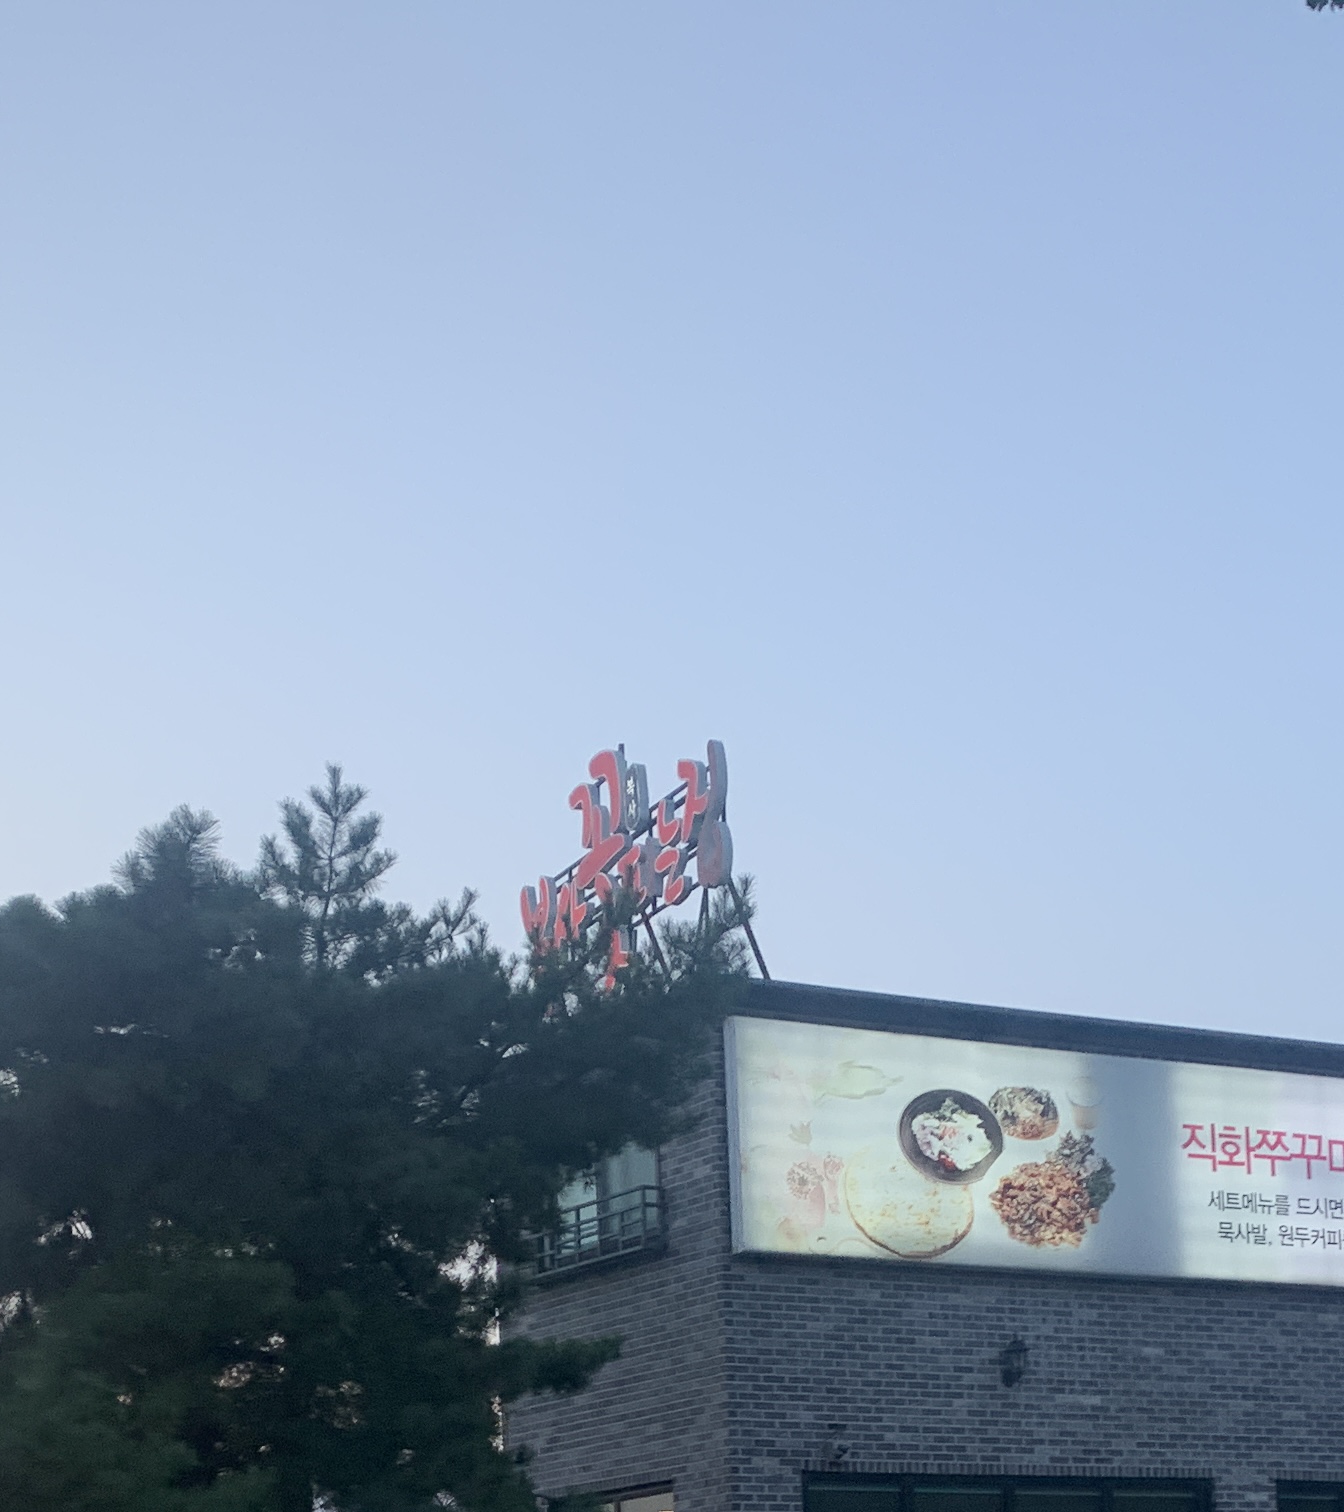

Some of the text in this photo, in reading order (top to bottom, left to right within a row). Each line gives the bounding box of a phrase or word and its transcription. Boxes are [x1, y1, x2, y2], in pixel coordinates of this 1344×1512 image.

[1207, 1190, 1290, 1216] 세트메뉴를
[1296, 1195, 1344, 1220] 드시면
[1217, 1221, 1272, 1246] 묵사발,
